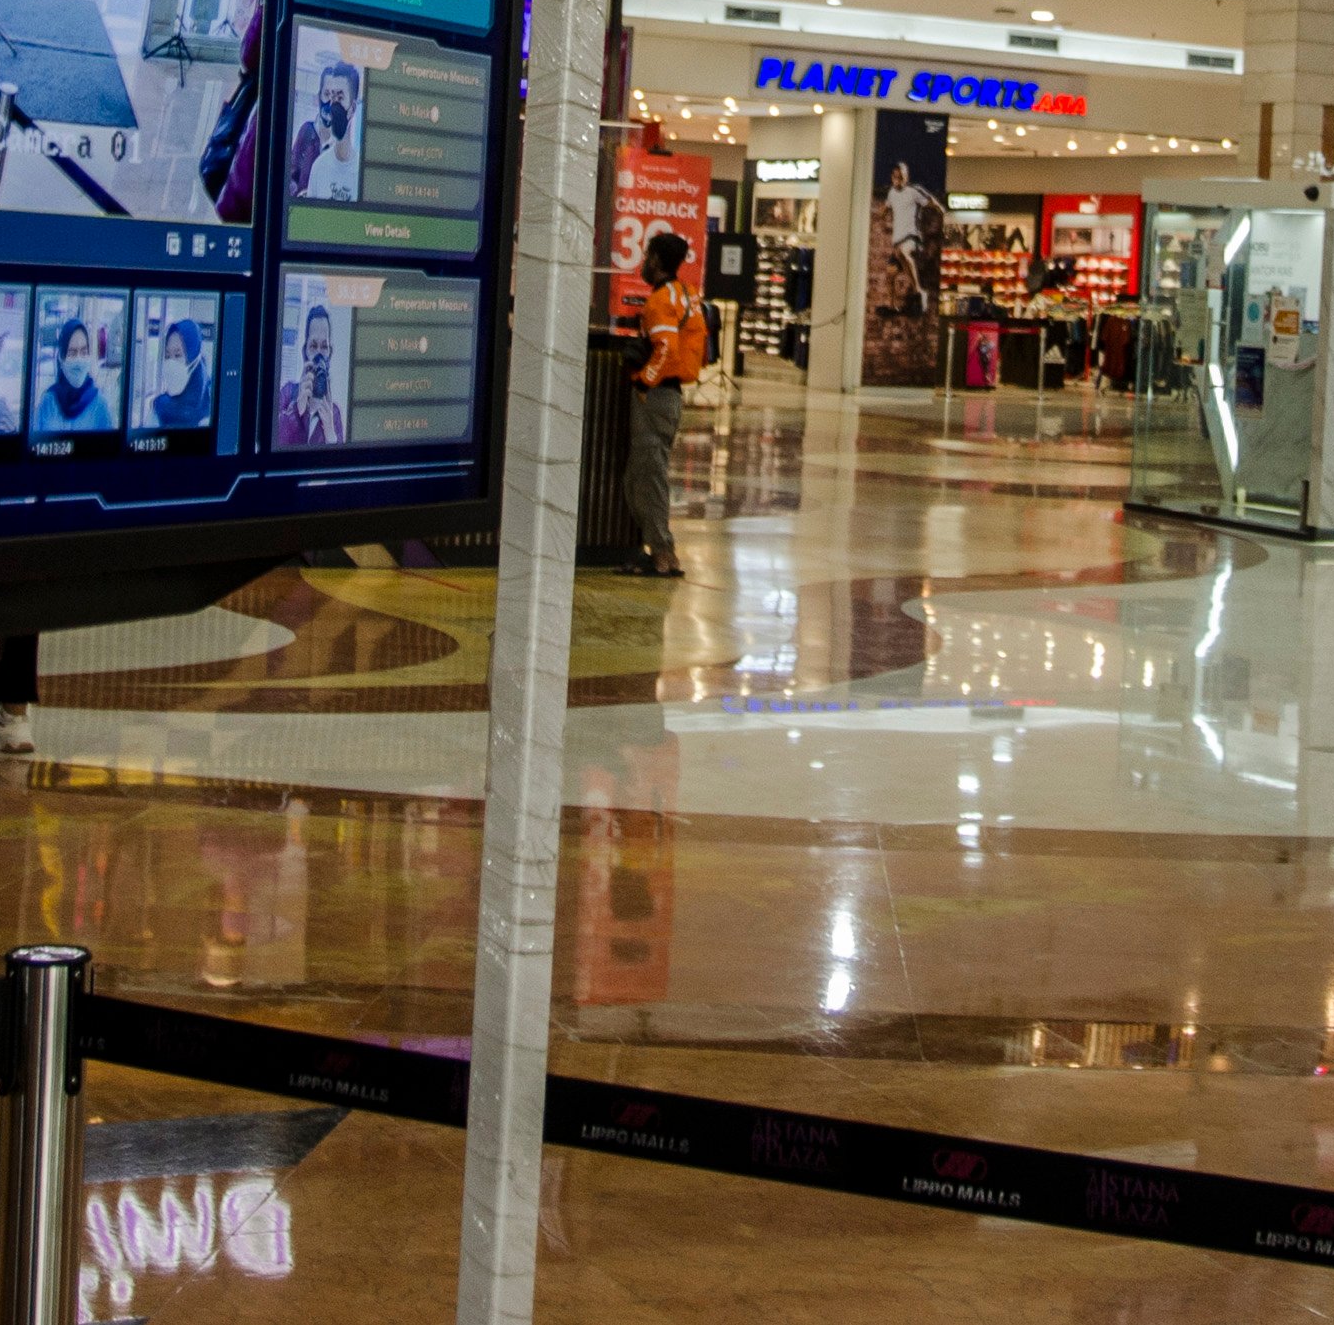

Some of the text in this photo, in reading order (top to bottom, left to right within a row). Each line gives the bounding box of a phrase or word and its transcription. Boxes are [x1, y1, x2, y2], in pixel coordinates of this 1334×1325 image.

[401, 62, 449, 82] Temperature
[756, 57, 898, 98] PLANET
[399, 103, 411, 117] No
[110, 129, 142, 165] 01
[636, 175, 701, 198] ShopeePay
[615, 195, 701, 220] CASHBACK
[364, 223, 411, 239] View Details
[390, 297, 437, 312] Temperature
[387, 337, 399, 352] No
[35, 441, 73, 457] 14:13:24
[133, 438, 167, 452] 14:13:15
[288, 1072, 390, 1104] LIPPO MALLS
[580, 1123, 691, 1156] LIPPO MALLS
[901, 1174, 1022, 1208] LIPPO MALLS
[1254, 1227, 1312, 1252] LIPPO
